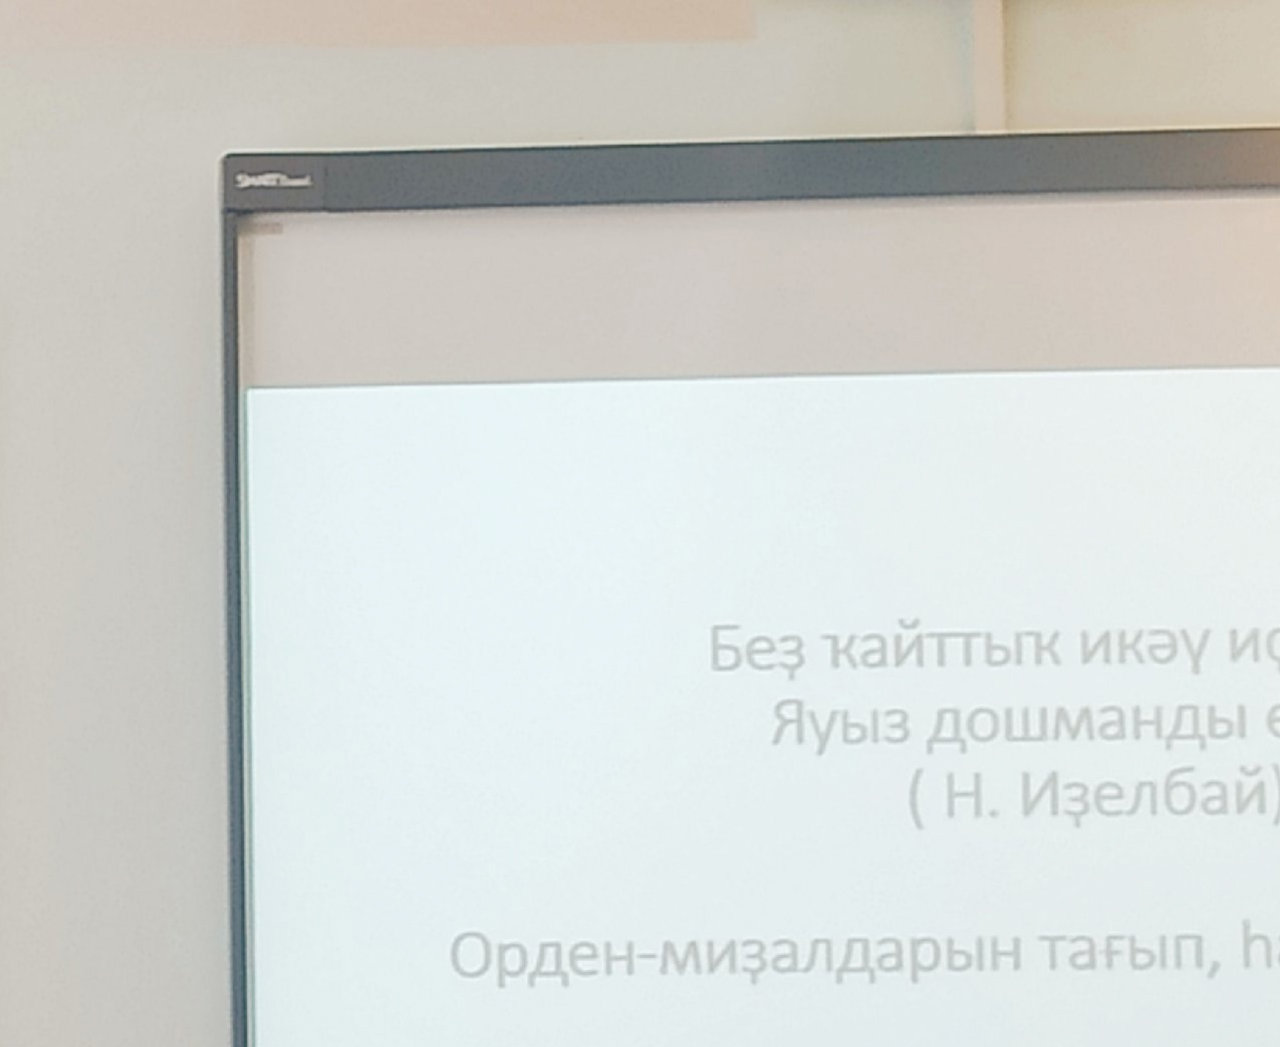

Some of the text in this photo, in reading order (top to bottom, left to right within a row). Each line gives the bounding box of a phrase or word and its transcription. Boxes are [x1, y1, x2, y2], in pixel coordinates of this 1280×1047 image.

[709, 623, 807, 682] Беҙ
[1080, 627, 1212, 676] икәү
[771, 698, 911, 757] Яуыз
[925, 703, 1247, 755] дошманды
[449, 930, 1023, 989] Орден-миҙалдарын
[1037, 933, 1222, 980] тағып,
